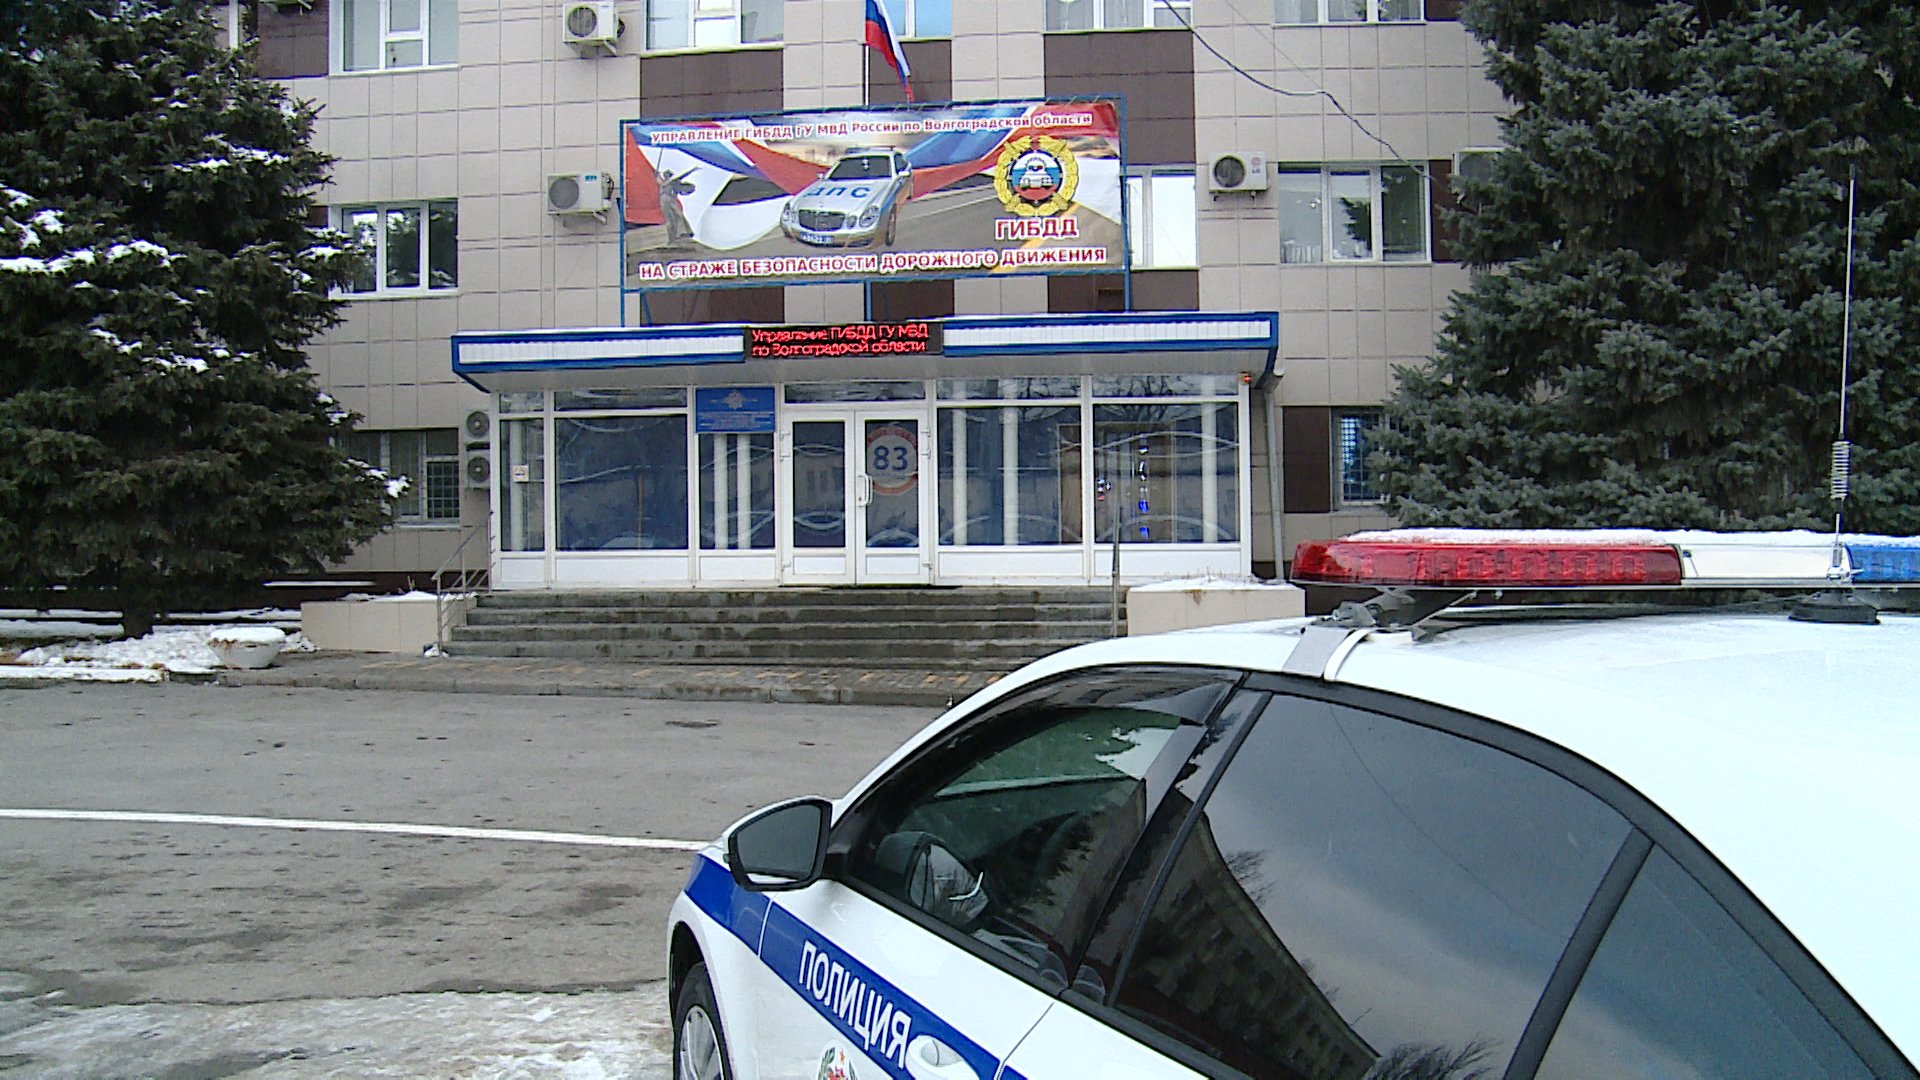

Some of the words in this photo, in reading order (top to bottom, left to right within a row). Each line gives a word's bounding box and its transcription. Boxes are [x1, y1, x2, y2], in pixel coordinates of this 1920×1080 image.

[745, 126, 793, 139] ГИБДД
[797, 125, 813, 137] ГУ
[818, 122, 849, 136] МВД
[852, 119, 900, 134] России
[903, 120, 921, 134] по
[924, 116, 1030, 133] Волгоградской
[1034, 113, 1092, 127] области
[997, 219, 1078, 238] ГИБДД
[641, 265, 664, 279] НА
[669, 261, 737, 276] СТРАЖЕ
[742, 256, 877, 273] БЕЗОПАСНОСТИ
[882, 252, 996, 270] ДОРОЖНОГО
[1002, 248, 1105, 267] ДВИЖЕНИЯ
[752, 329, 828, 343] Управление
[831, 326, 877, 339] ГИБДД
[880, 325, 894, 338] ГУ
[899, 323, 929, 338] МВД
[752, 344, 770, 356] по
[773, 340, 869, 356] Волгоградской
[872, 340, 926, 352] области
[873, 445, 909, 471] 83
[799, 939, 912, 1070] ПОЛИЦИЯ
